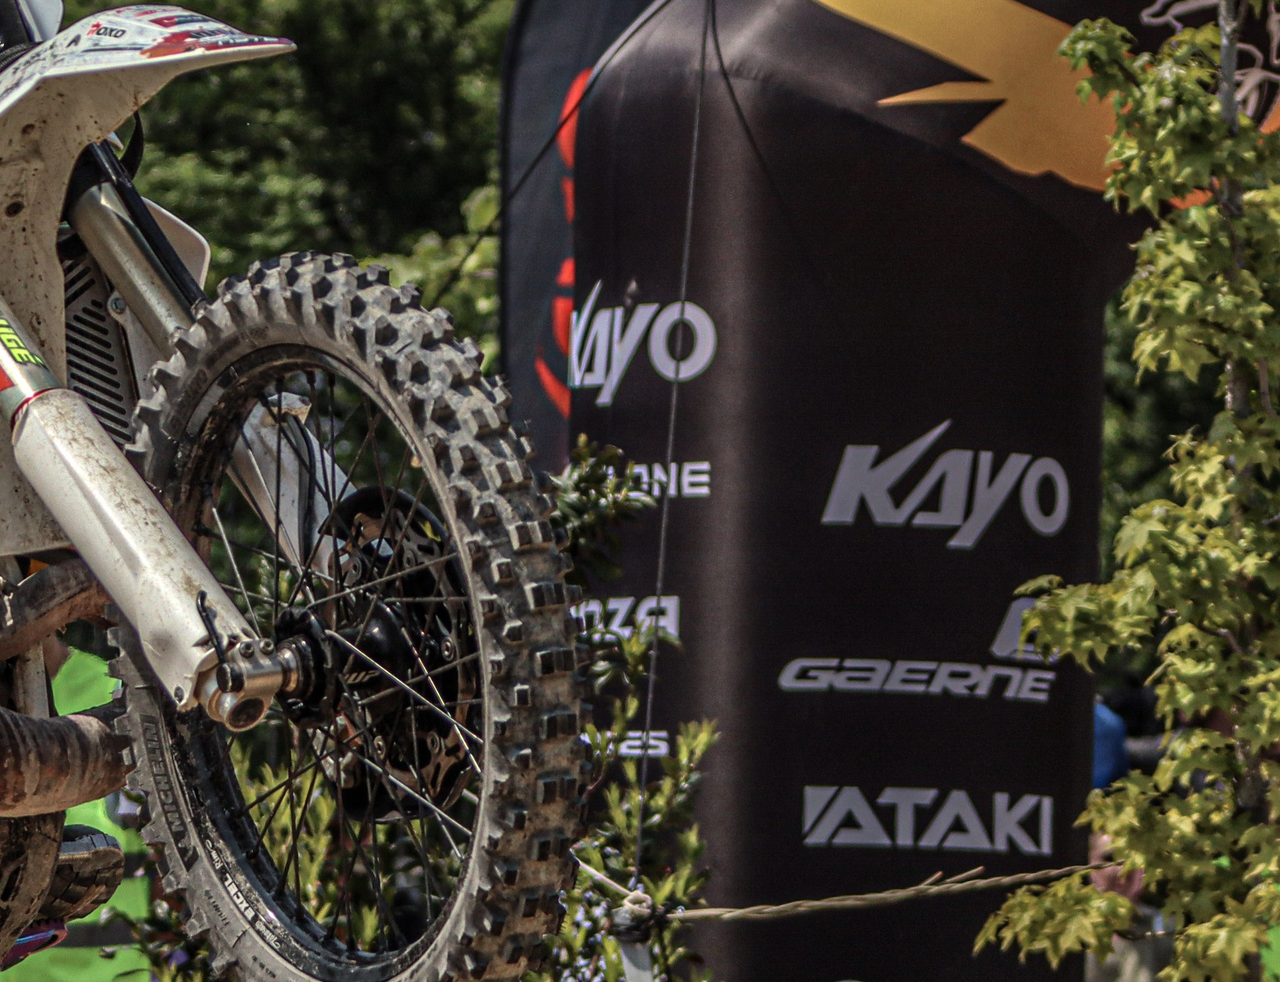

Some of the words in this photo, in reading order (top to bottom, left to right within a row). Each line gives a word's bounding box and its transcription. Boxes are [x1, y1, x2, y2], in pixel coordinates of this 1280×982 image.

[822, 419, 1070, 550] KAYO
[143, 722, 185, 833] MICHELIN
[223, 873, 256, 921] EXCEL
